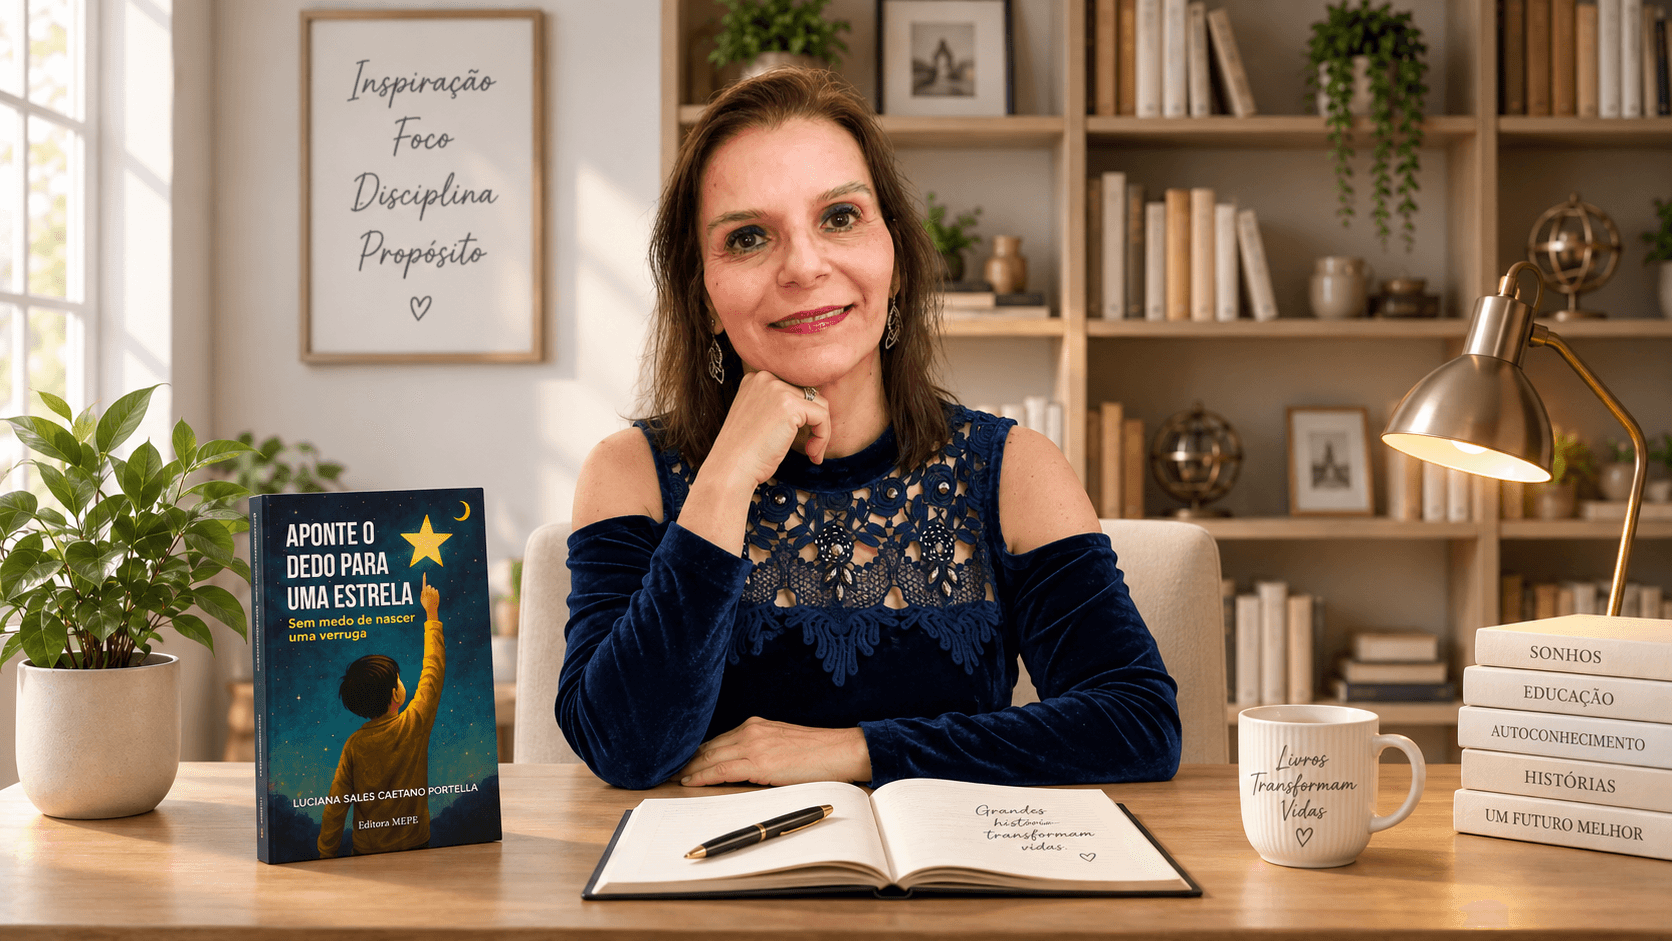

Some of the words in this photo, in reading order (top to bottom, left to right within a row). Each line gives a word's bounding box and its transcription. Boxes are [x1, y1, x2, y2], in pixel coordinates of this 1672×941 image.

[347, 59, 496, 109] Inspiração
[393, 116, 454, 157] Foco
[350, 172, 499, 221] Disciplina
[358, 230, 487, 280] Propósito
[285, 521, 358, 547] APONTE
[362, 521, 375, 545] O
[286, 553, 335, 578] DEDO
[341, 551, 389, 576] PARA
[287, 585, 329, 610] UMA
[334, 581, 414, 608] ESTRELA
[288, 618, 316, 629] Sem
[319, 615, 354, 627] medo
[357, 614, 373, 626] de
[375, 614, 416, 625] nascer
[289, 632, 316, 642] uma
[319, 629, 367, 642] verruga
[1529, 645, 1602, 664] SONHOS
[1523, 684, 1615, 708] EDUCAÇÃO
[1491, 724, 1646, 751] AUTOCONHECIMENTO
[1275, 744, 1329, 771] Livros
[1250, 771, 1358, 797] Transformam
[1524, 770, 1616, 793] HISTÓRIAS
[293, 795, 341, 808] LUCIANA
[343, 792, 375, 803] SALES
[377, 788, 426, 800] CAETANO
[428, 783, 479, 795] PORTELLA
[358, 819, 390, 830] Editora
[392, 816, 419, 827] MEPE
[976, 804, 1046, 817] Grandes
[1280, 799, 1328, 821] Vidas
[983, 829, 1095, 841] transformam
[1485, 808, 1509, 824] UM
[1513, 812, 1573, 831] FUTURO
[1577, 819, 1644, 841] MELHOR
